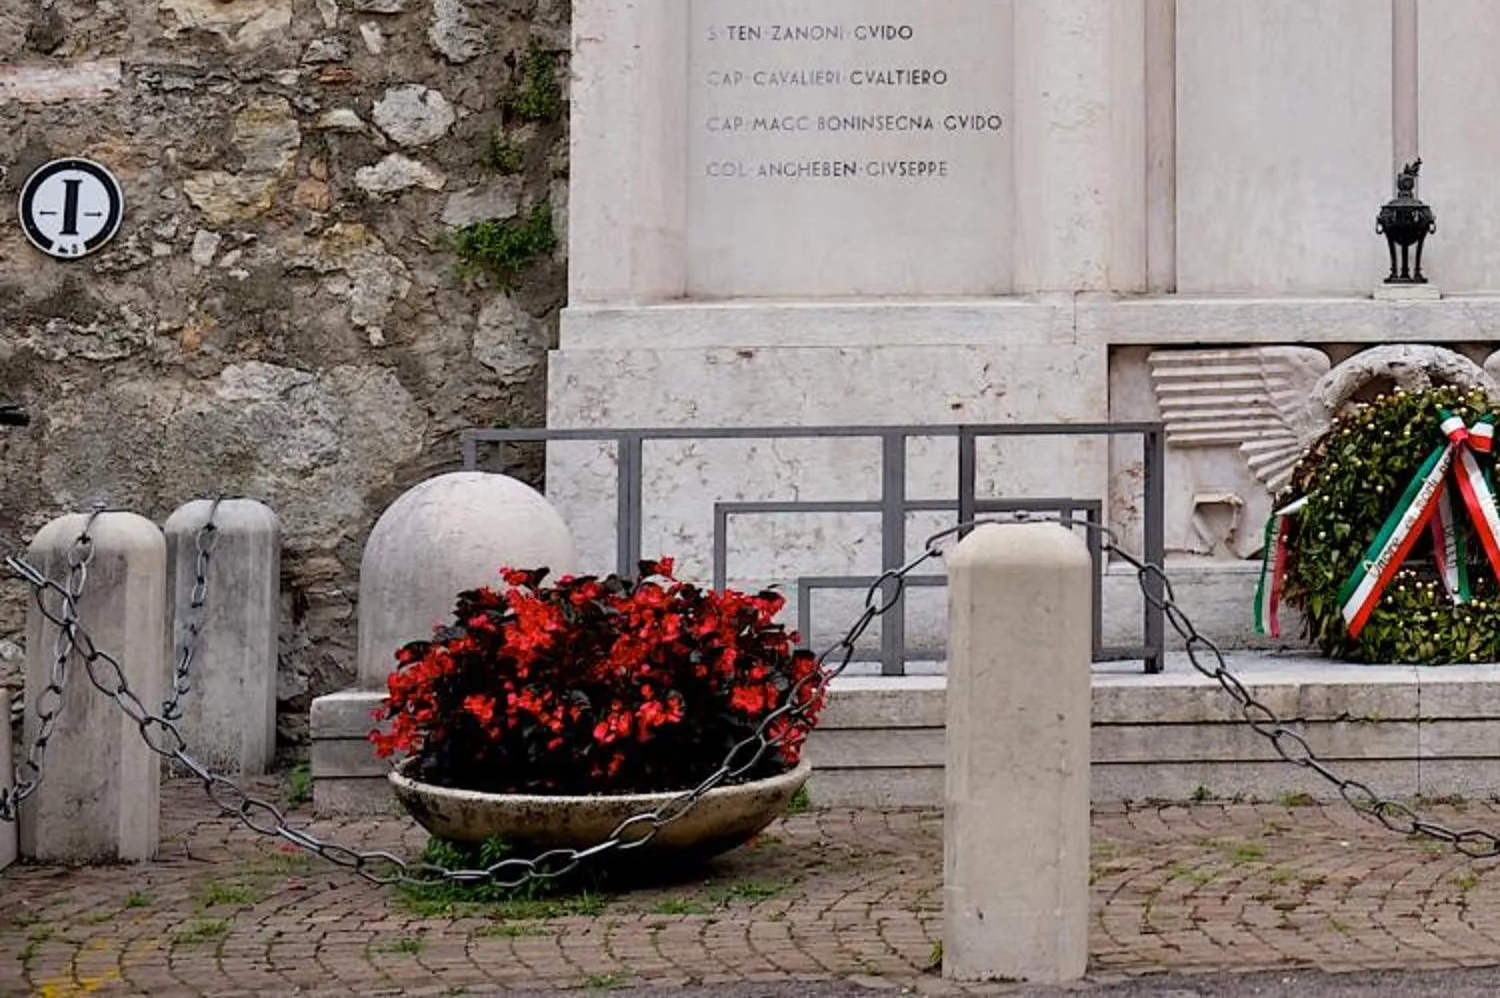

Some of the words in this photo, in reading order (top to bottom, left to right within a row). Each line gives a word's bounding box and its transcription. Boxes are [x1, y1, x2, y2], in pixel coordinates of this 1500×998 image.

[726, 25, 762, 41] TEN
[771, 25, 844, 41] ZANONI
[704, 115, 744, 132] CAP
[704, 161, 748, 178] COL
